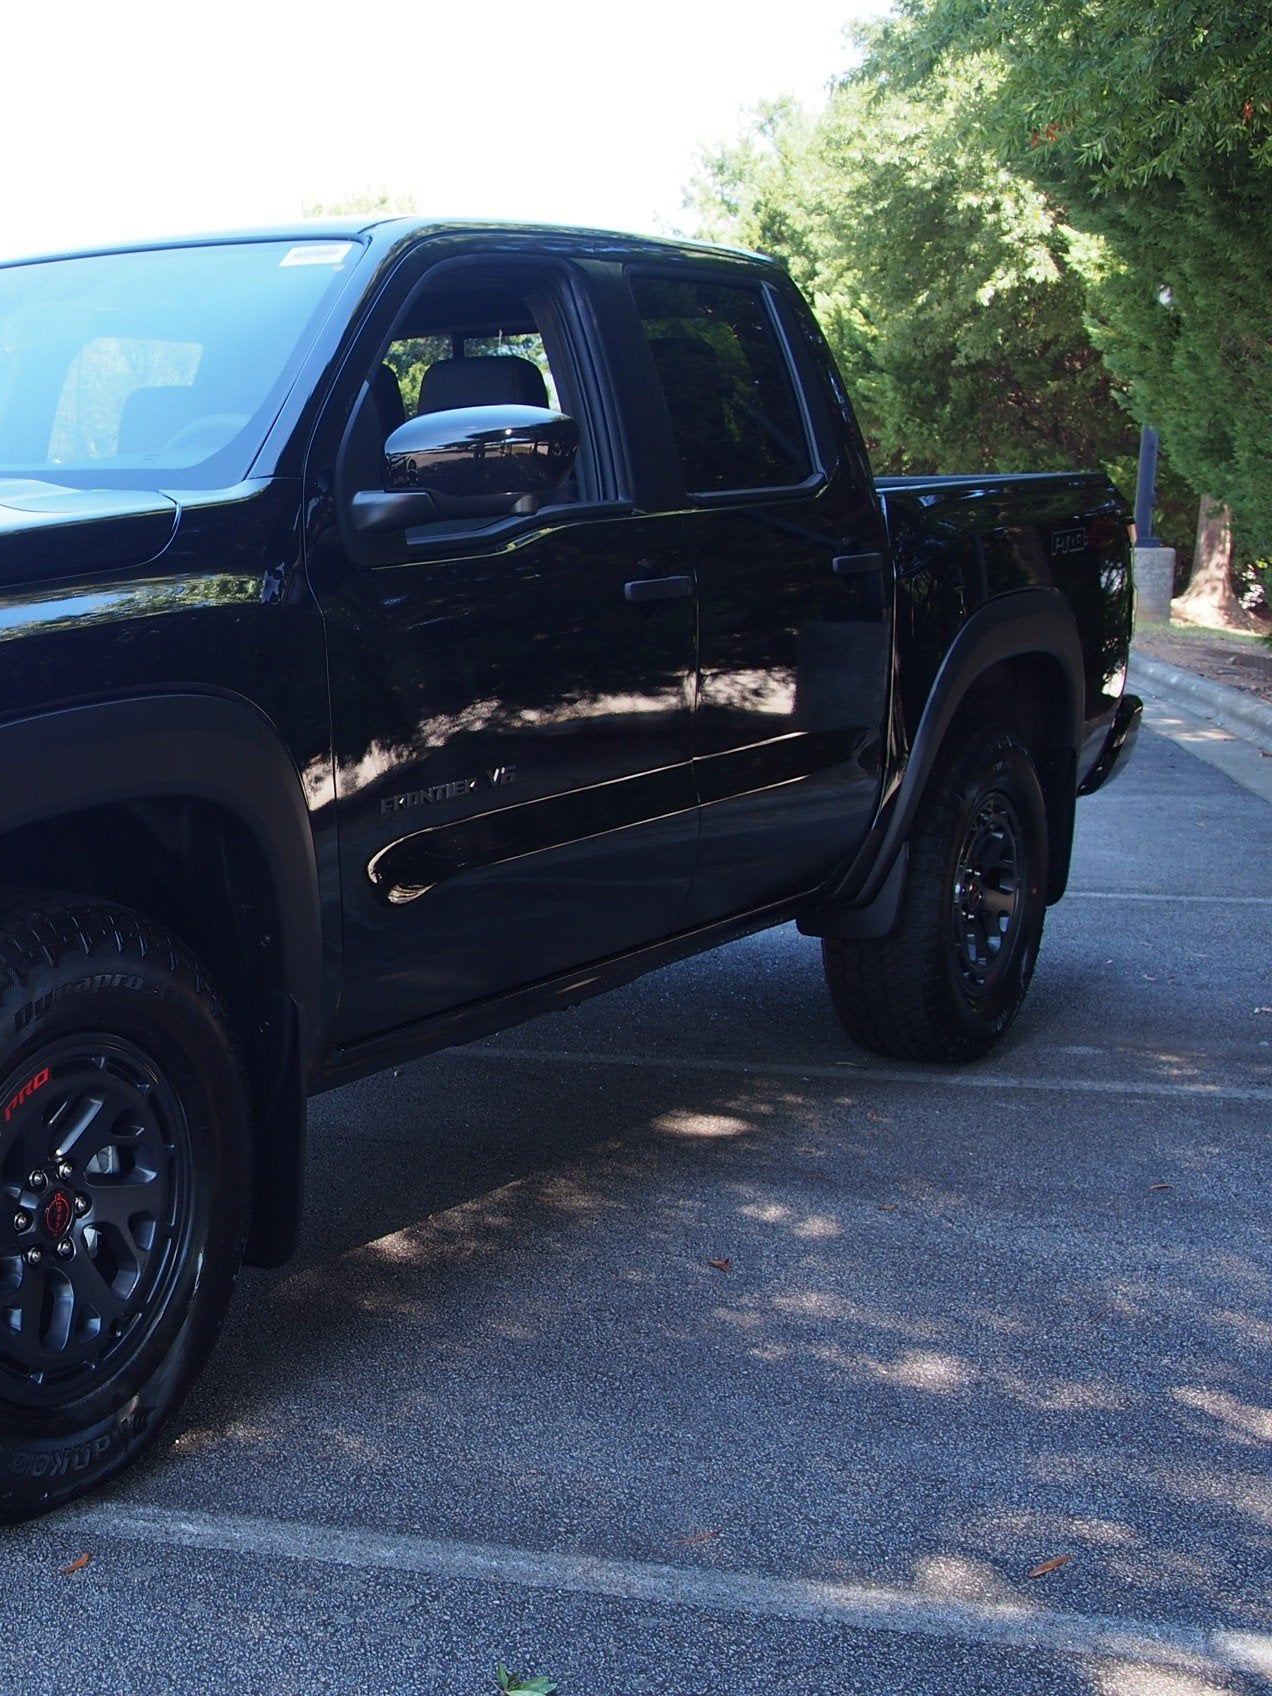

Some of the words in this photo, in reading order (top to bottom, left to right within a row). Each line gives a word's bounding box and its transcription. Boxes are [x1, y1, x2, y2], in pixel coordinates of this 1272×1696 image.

[380, 778, 478, 815] FRONTIER
[484, 764, 517, 788] V6
[5, 1067, 49, 1122] PRO
